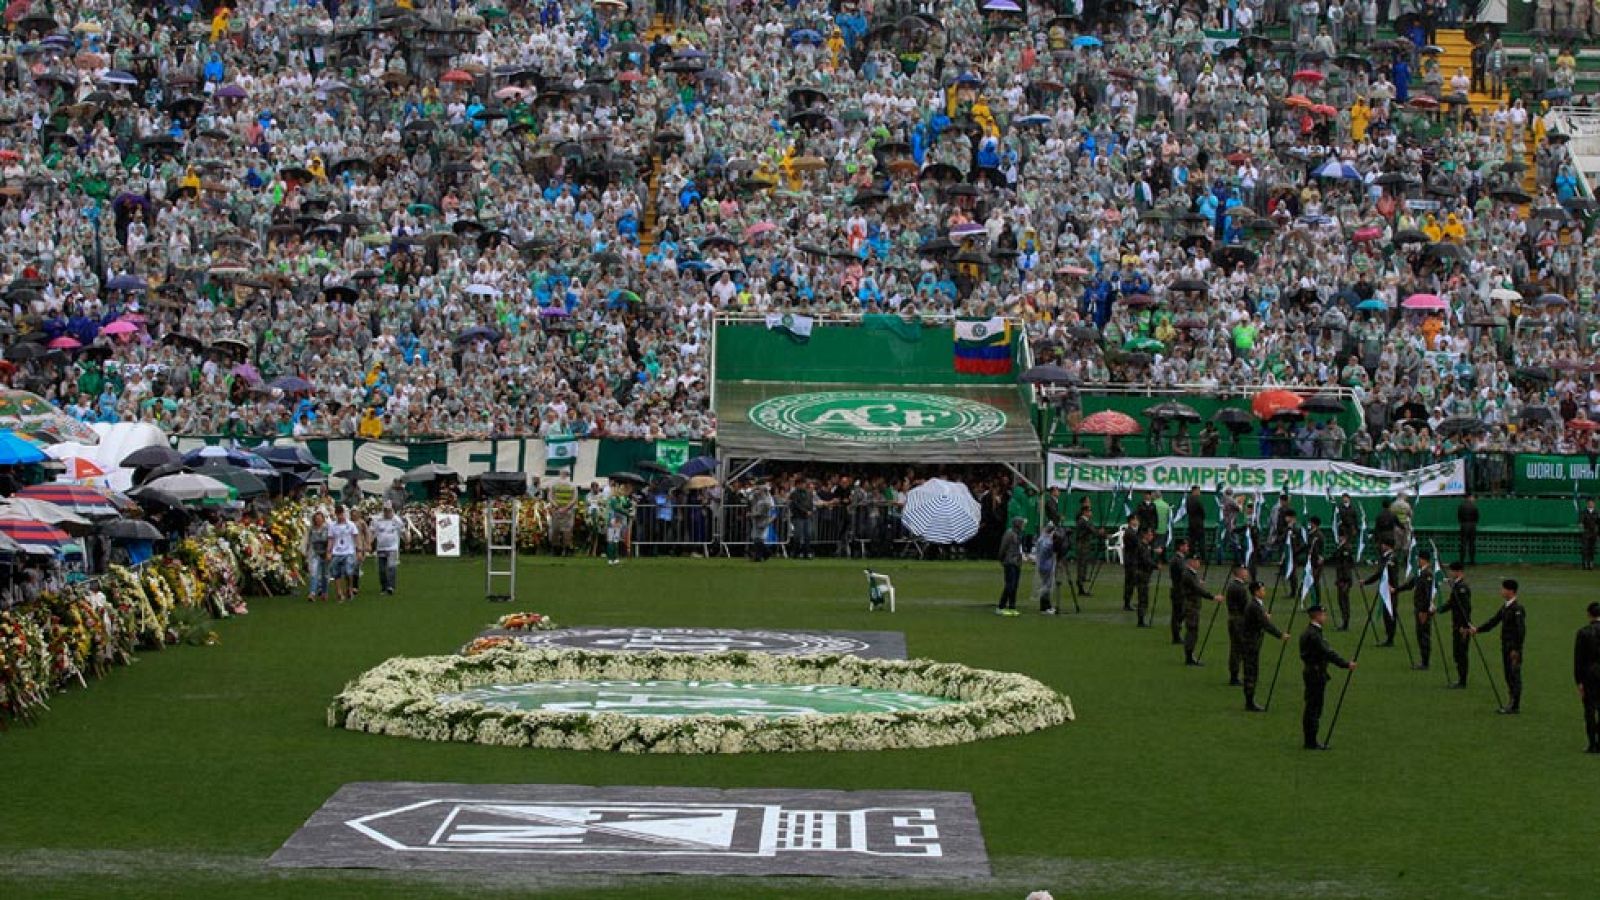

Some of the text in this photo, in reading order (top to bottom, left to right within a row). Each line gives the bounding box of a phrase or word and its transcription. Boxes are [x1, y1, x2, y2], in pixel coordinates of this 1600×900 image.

[1054, 462, 1147, 484] ETERNOS
[1272, 468, 1305, 488] EM
[1310, 470, 1390, 491] NOSSOS
[1526, 462, 1566, 480] WORLD,
